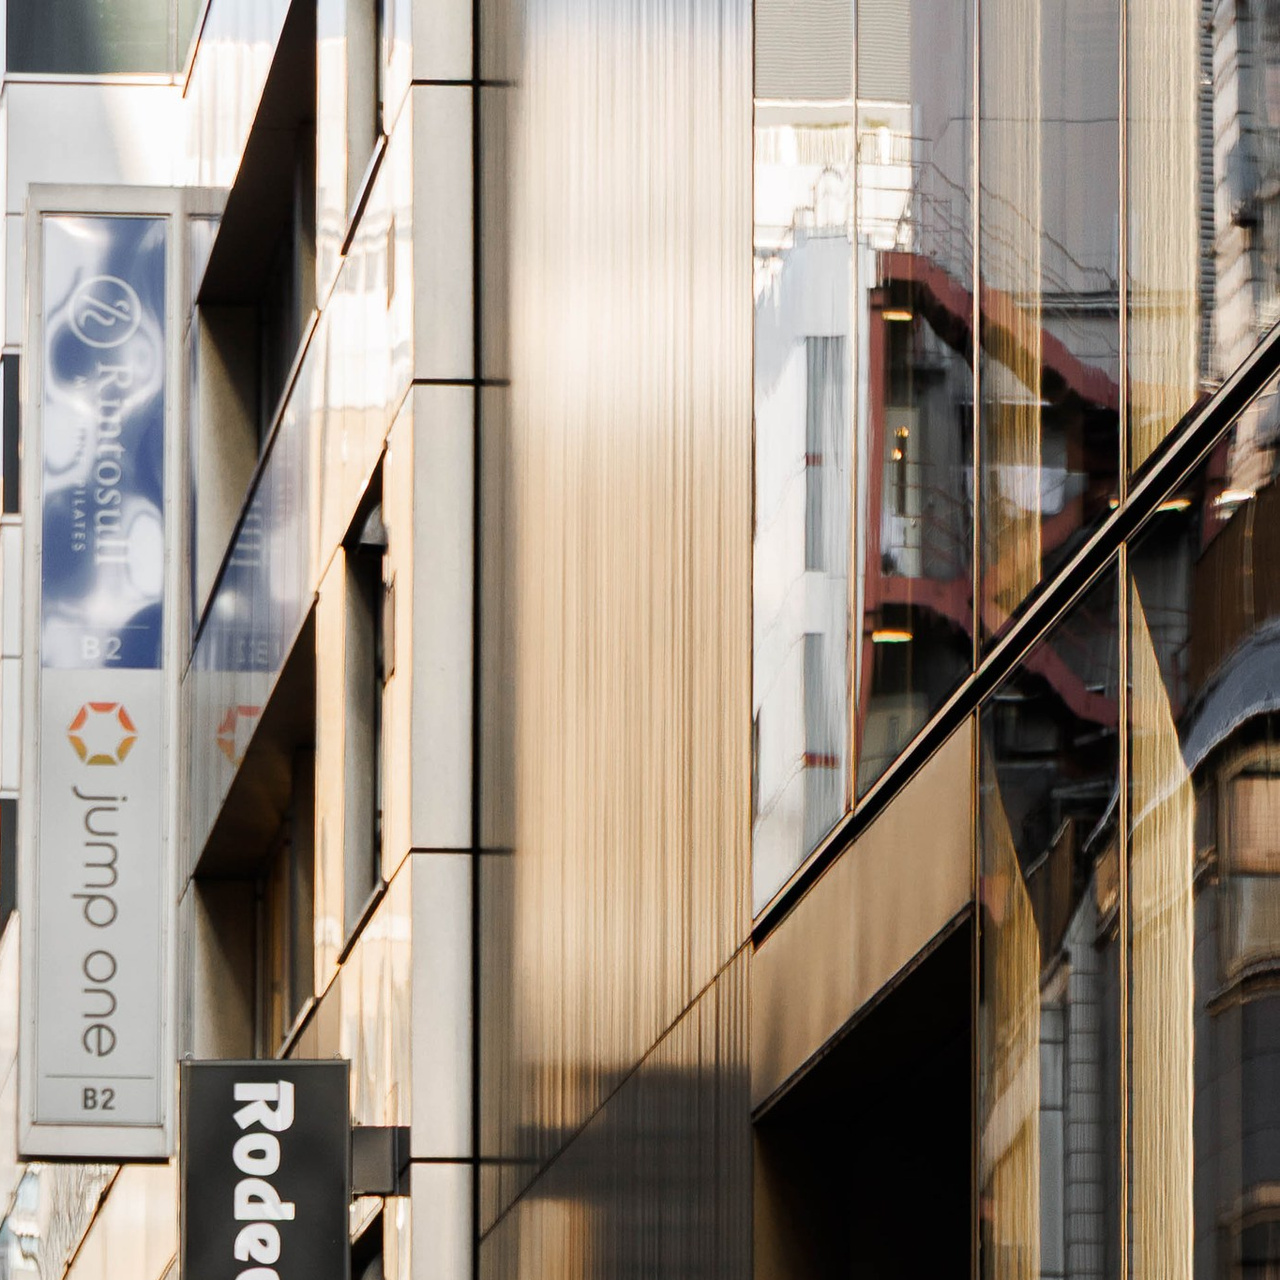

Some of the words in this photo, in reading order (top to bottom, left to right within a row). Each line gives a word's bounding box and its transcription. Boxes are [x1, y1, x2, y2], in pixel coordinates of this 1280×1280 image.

[80, 636, 122, 661] B2
[71, 785, 128, 928] jump
[82, 950, 118, 1058] one
[82, 1086, 117, 1111] B2
